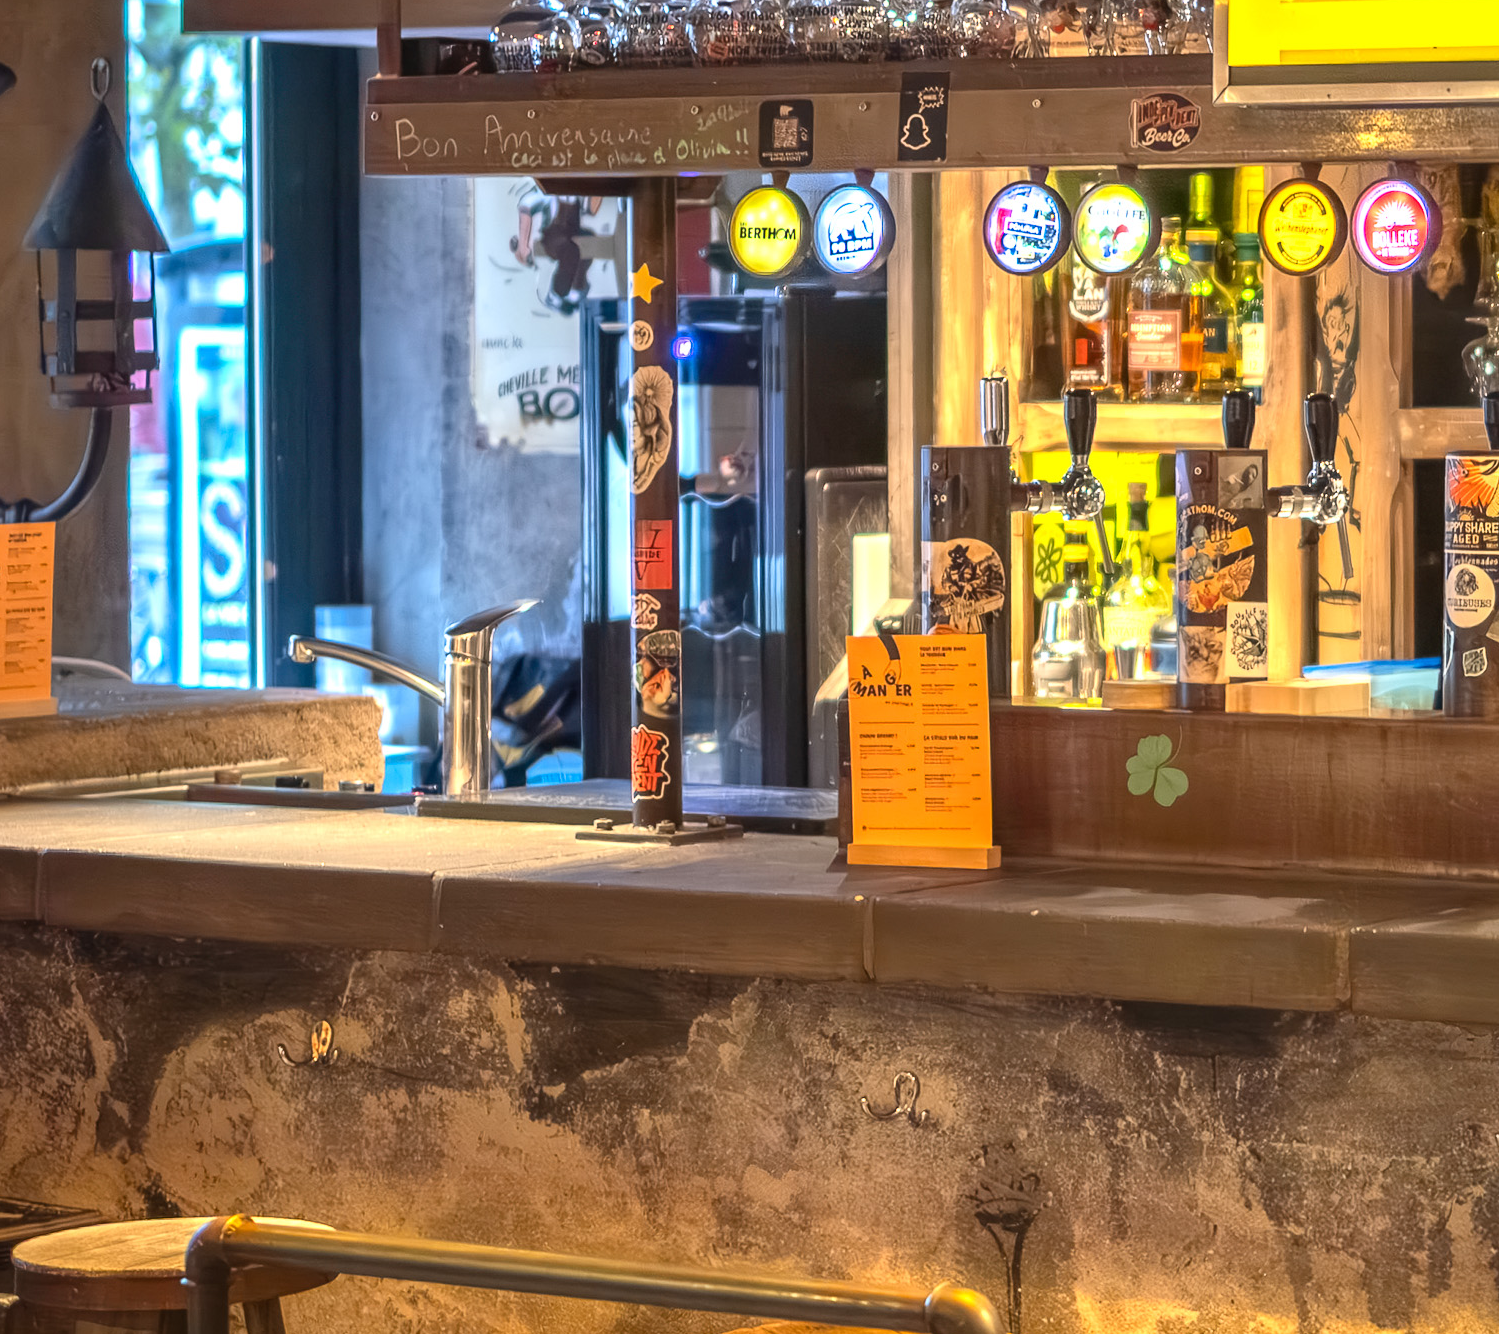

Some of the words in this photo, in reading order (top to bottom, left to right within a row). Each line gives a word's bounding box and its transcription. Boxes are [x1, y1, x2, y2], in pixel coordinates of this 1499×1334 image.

[395, 118, 457, 160] Bon
[483, 114, 651, 155] Anniversaire
[1141, 127, 1174, 146] Beer
[739, 226, 797, 241] BERTHOM
[1372, 229, 1419, 249] BOLLEKE
[1464, 521, 1499, 534] SHARE
[1452, 533, 1480, 545] AGED
